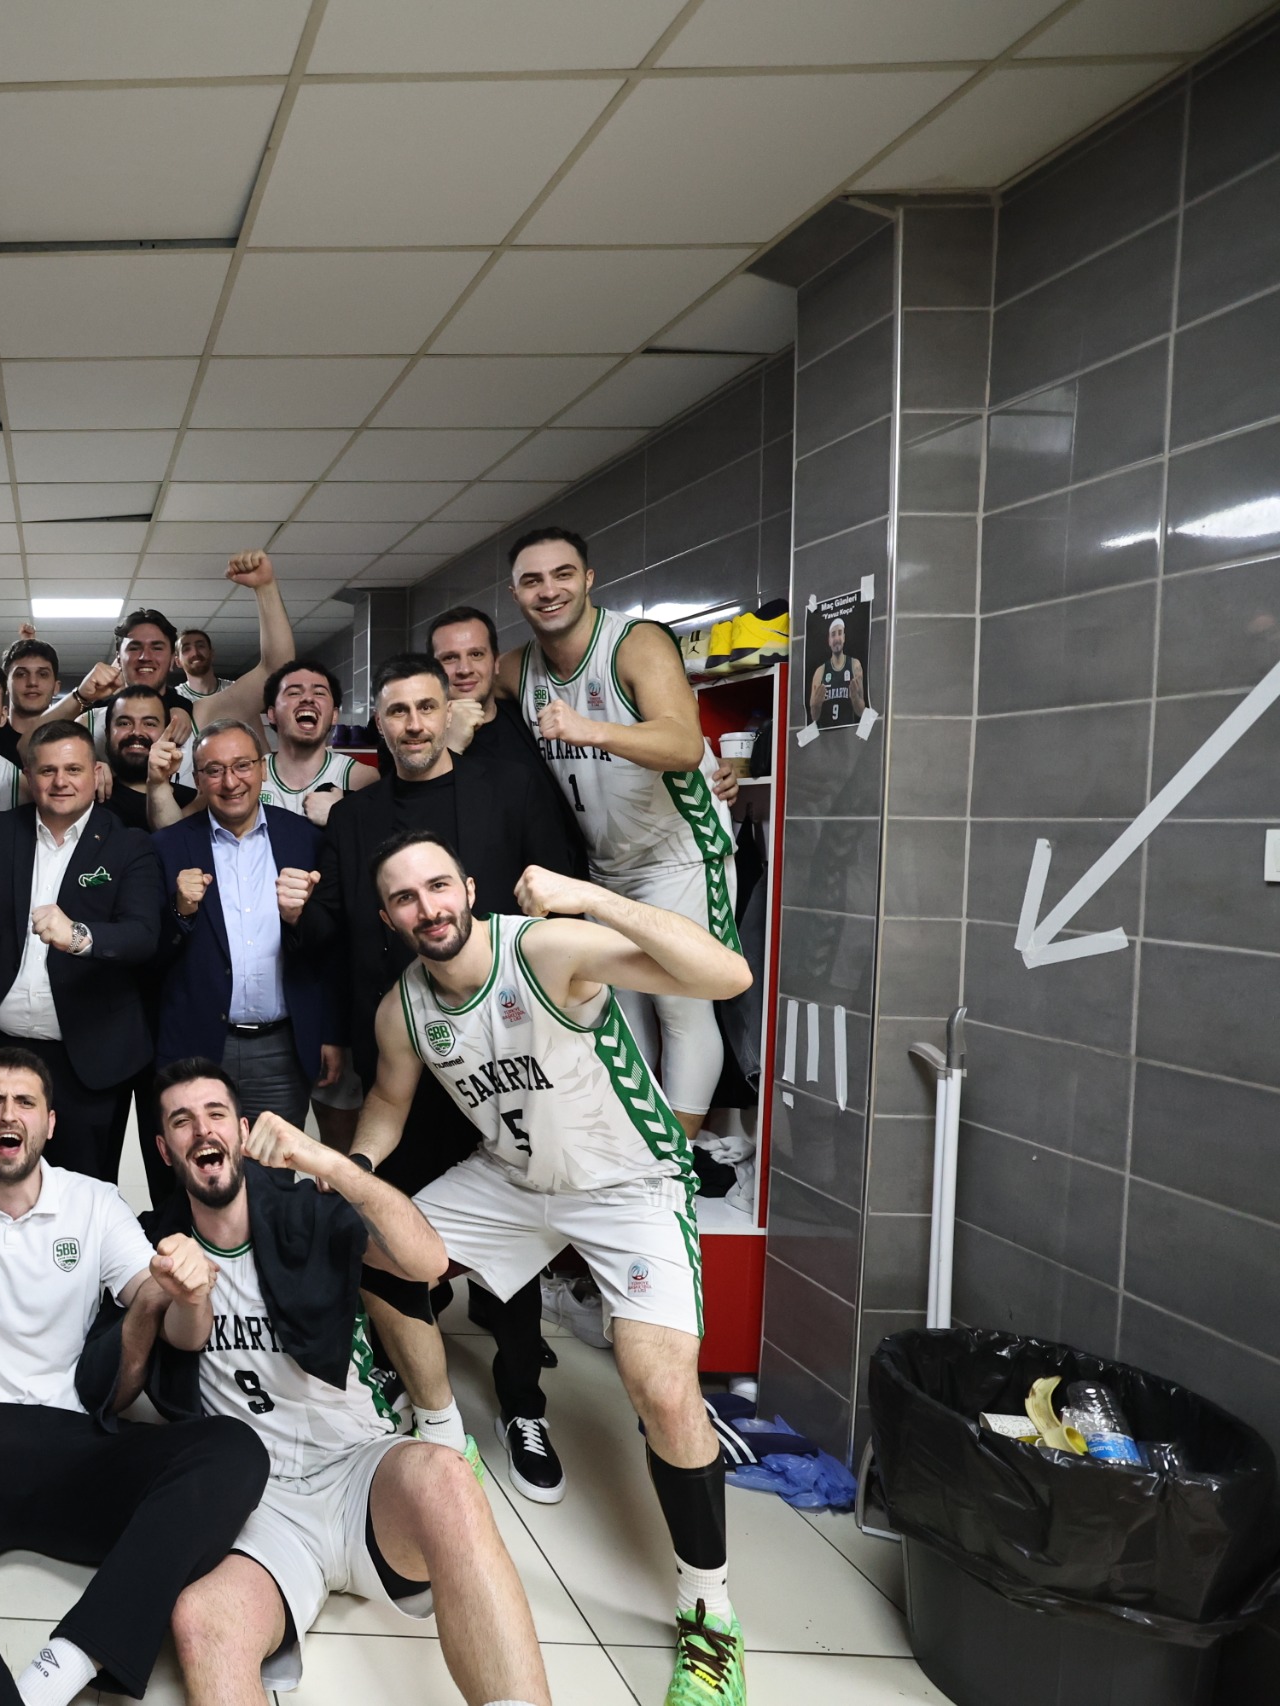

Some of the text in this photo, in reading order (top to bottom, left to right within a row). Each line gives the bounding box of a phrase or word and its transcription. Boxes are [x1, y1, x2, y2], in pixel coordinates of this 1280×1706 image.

[832, 704, 839, 720] 9
[568, 774, 585, 812] 1
[427, 1025, 451, 1042] SBB
[500, 1109, 533, 1157] 5
[56, 1242, 78, 1257] SBB
[200, 1314, 287, 1354] KARY
[234, 1370, 275, 1415] 9
